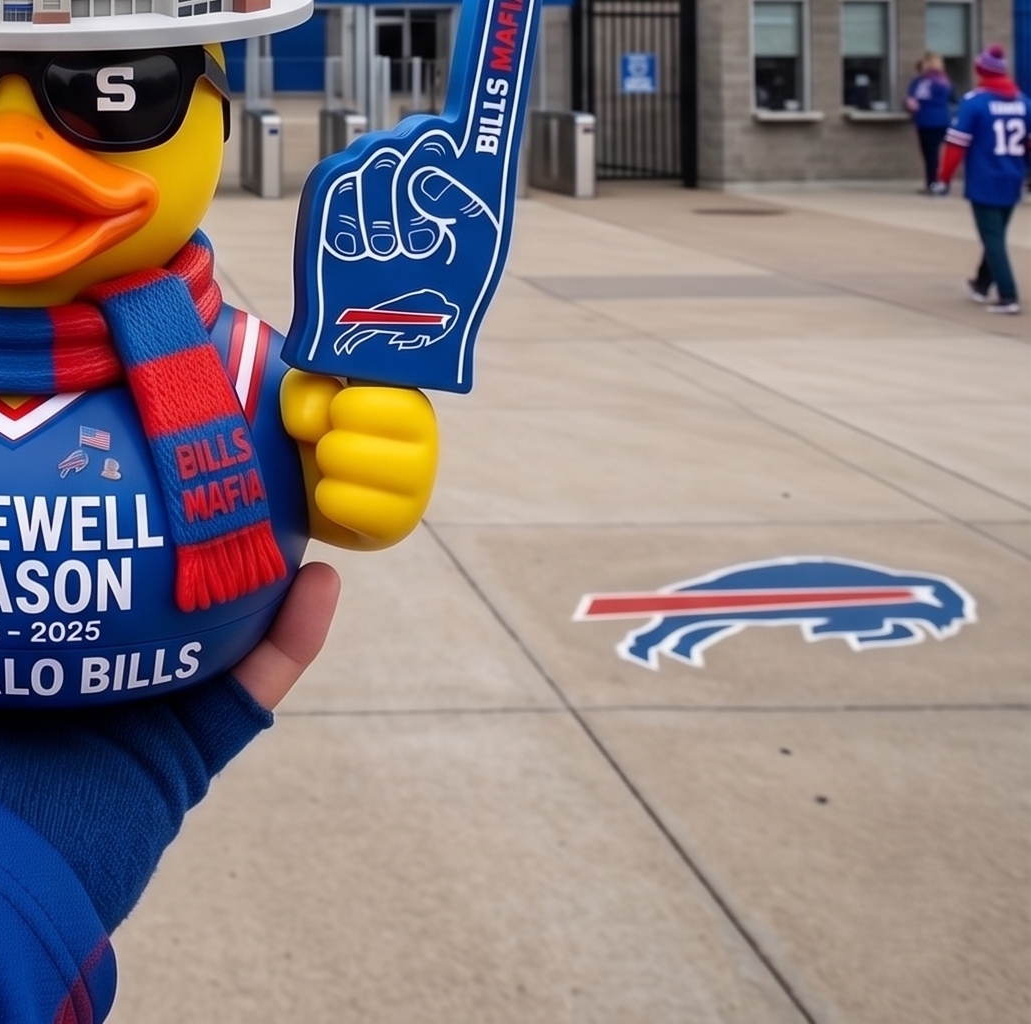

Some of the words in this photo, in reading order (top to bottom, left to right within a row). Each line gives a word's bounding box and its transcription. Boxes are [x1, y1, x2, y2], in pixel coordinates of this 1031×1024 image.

[95, 66, 137, 112] S
[475, 77, 509, 156] BILLS
[992, 117, 1027, 157] 12
[174, 427, 254, 481] BILLS
[180, 472, 267, 524] MAFIA
[30, 619, 102, 643] 2025
[79, 640, 203, 695] BILLS
